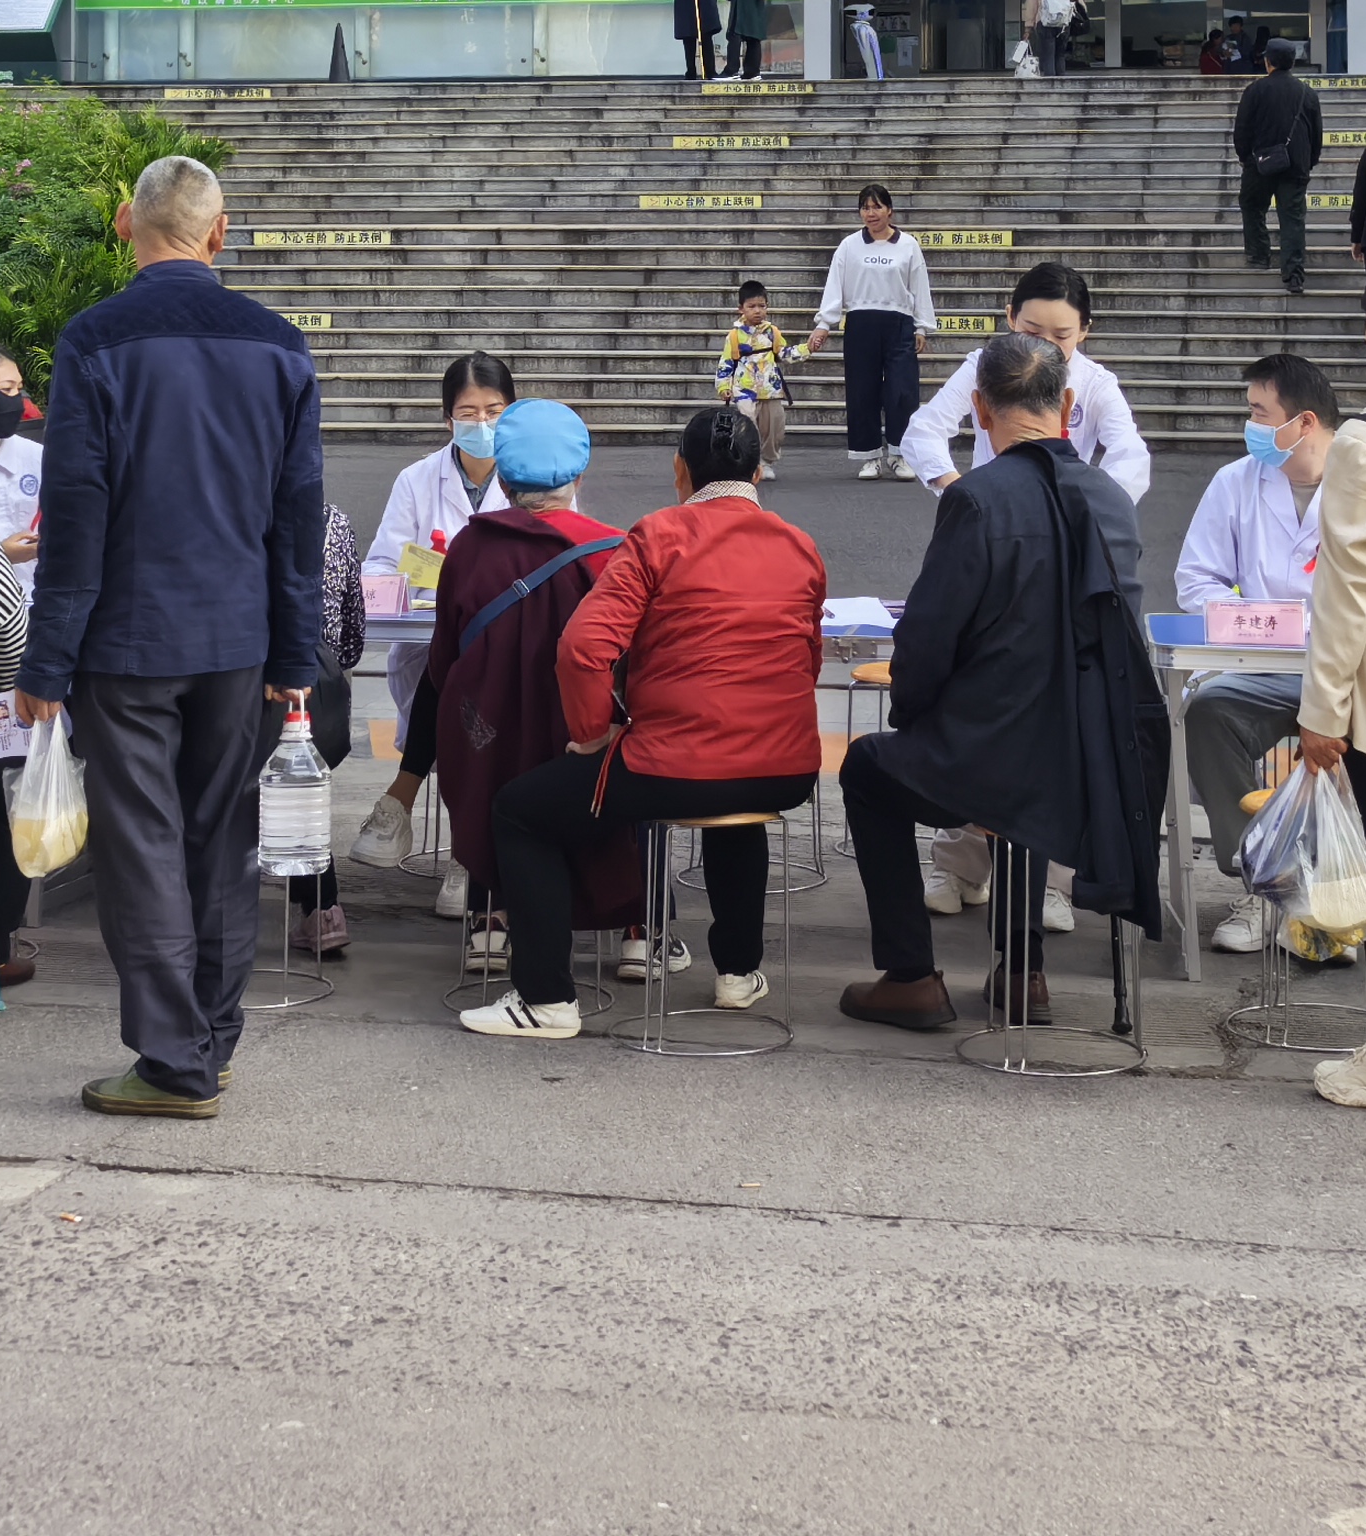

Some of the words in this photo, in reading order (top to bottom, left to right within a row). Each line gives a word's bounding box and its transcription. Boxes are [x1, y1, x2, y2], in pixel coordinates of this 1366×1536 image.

[695, 136, 736, 147] 小心台阶
[741, 136, 782, 146] 防止跌倒
[663, 195, 705, 208] 小心台阶
[711, 195, 755, 207] 防止跌倒
[280, 231, 327, 244] 小心台阶
[334, 231, 382, 244] 防止跌倒
[916, 232, 945, 245] 台阶
[951, 231, 1004, 244] 防止跌倒
[864, 255, 894, 265] color
[1233, 614, 1278, 630] 李建涛
